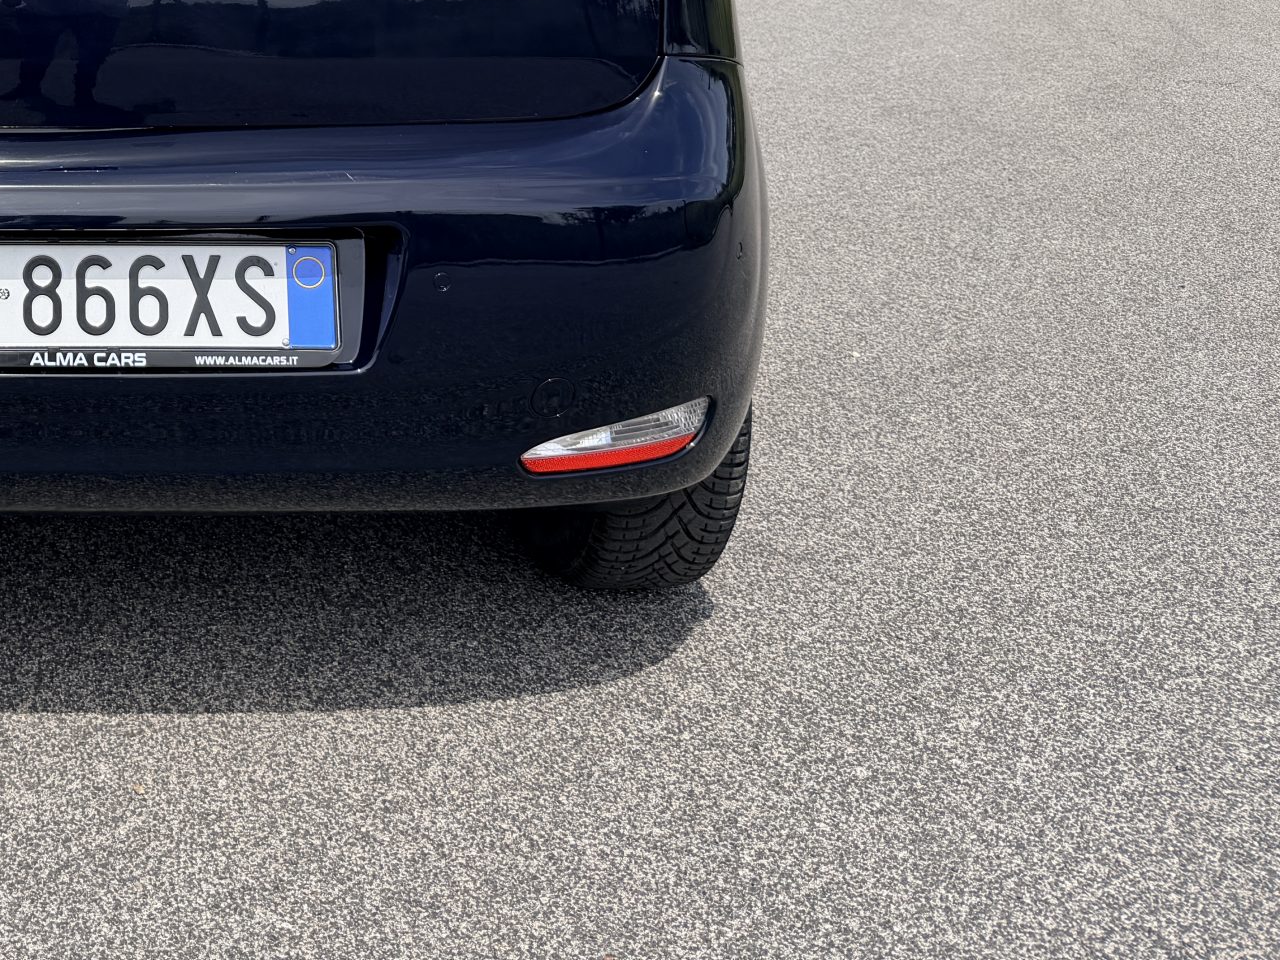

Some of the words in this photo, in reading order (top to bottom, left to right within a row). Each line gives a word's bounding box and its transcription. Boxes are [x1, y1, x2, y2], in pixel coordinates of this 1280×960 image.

[22, 254, 276, 337] 866XS
[30, 352, 88, 367] ALMA
[93, 352, 147, 367] CARS
[194, 355, 299, 366] WWW.ALMACARS.IT
